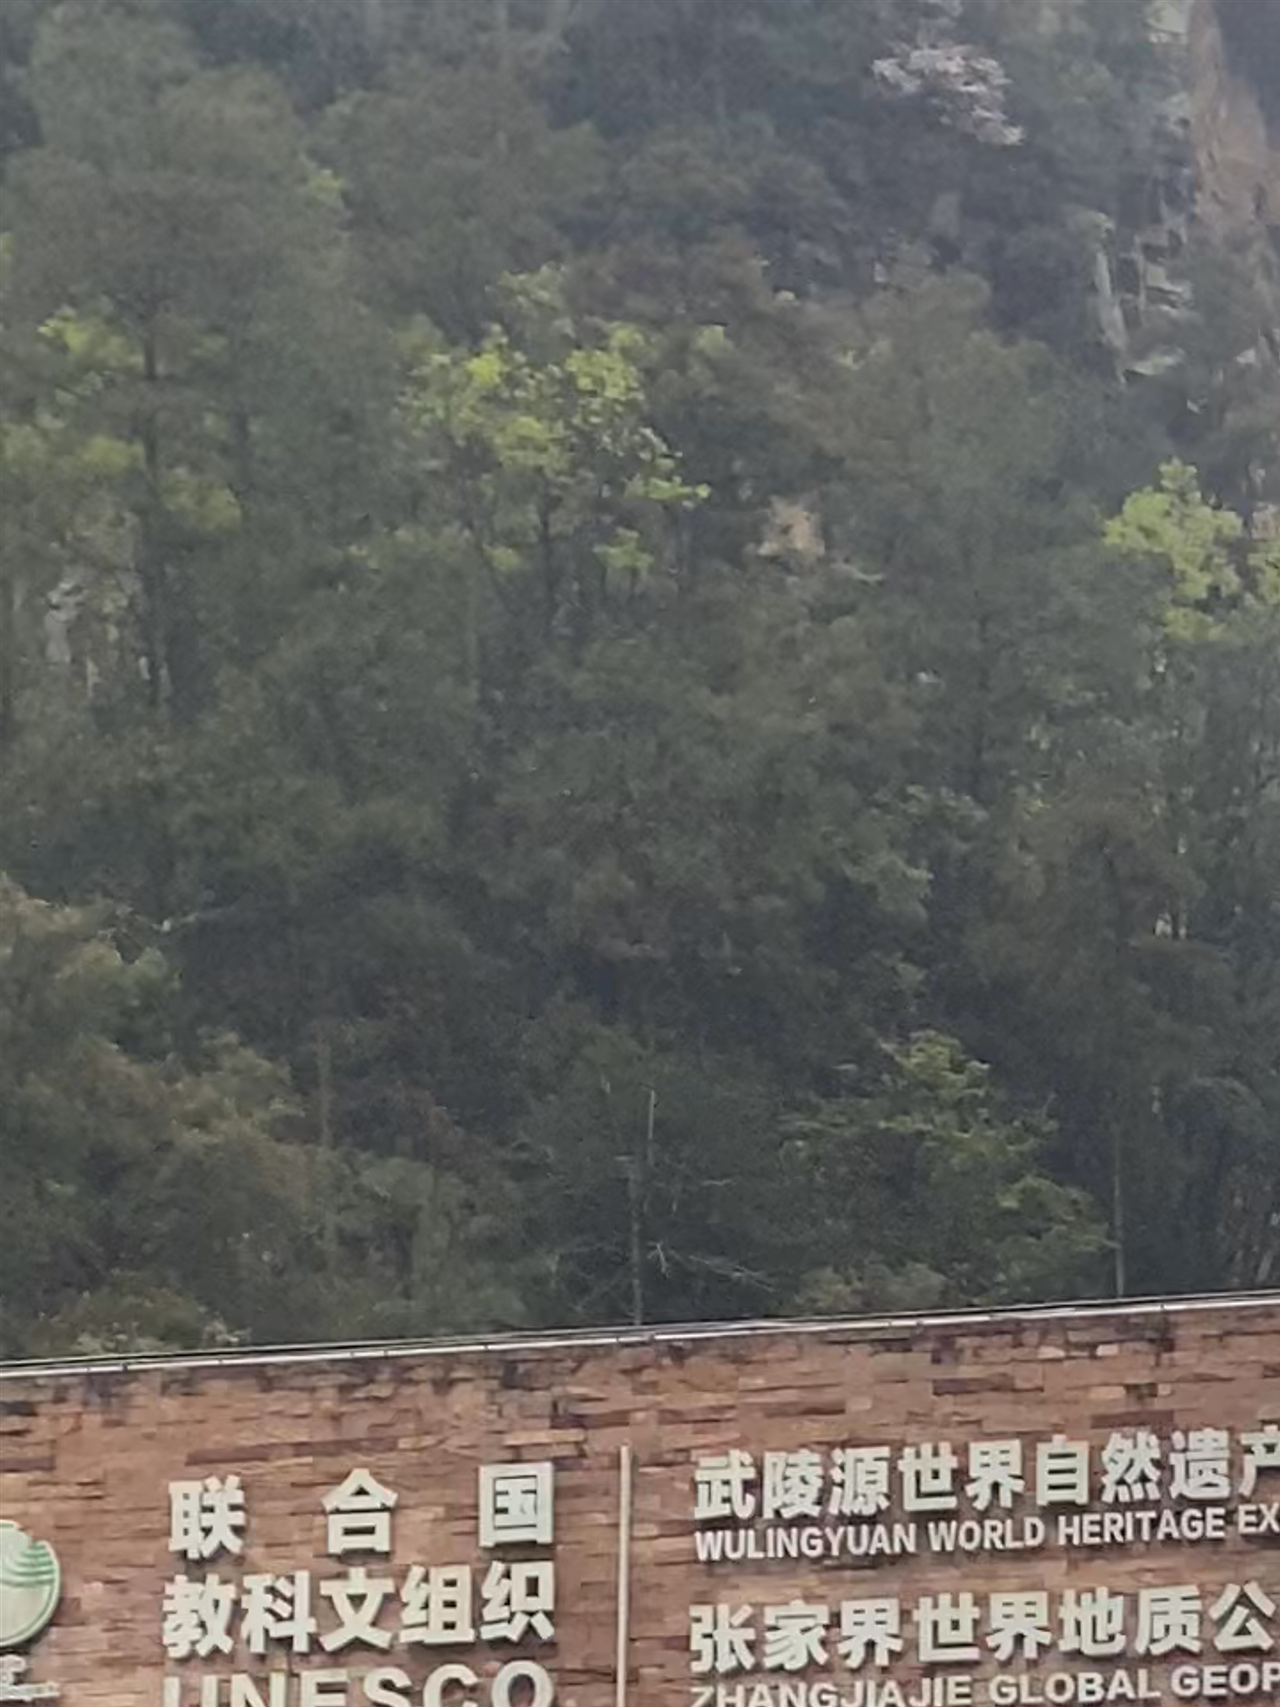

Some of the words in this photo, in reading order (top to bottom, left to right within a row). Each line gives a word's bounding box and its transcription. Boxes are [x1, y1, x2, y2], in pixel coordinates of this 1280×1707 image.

[168, 1461, 555, 1561] 联合国
[694, 1522, 917, 1562] WULINGYUAN
[928, 1516, 1046, 1552] WORLD
[1057, 1506, 1226, 1546] HERITAGE
[161, 1560, 556, 1659] 教科文组织
[987, 1668, 1161, 1706] GLOBAL
